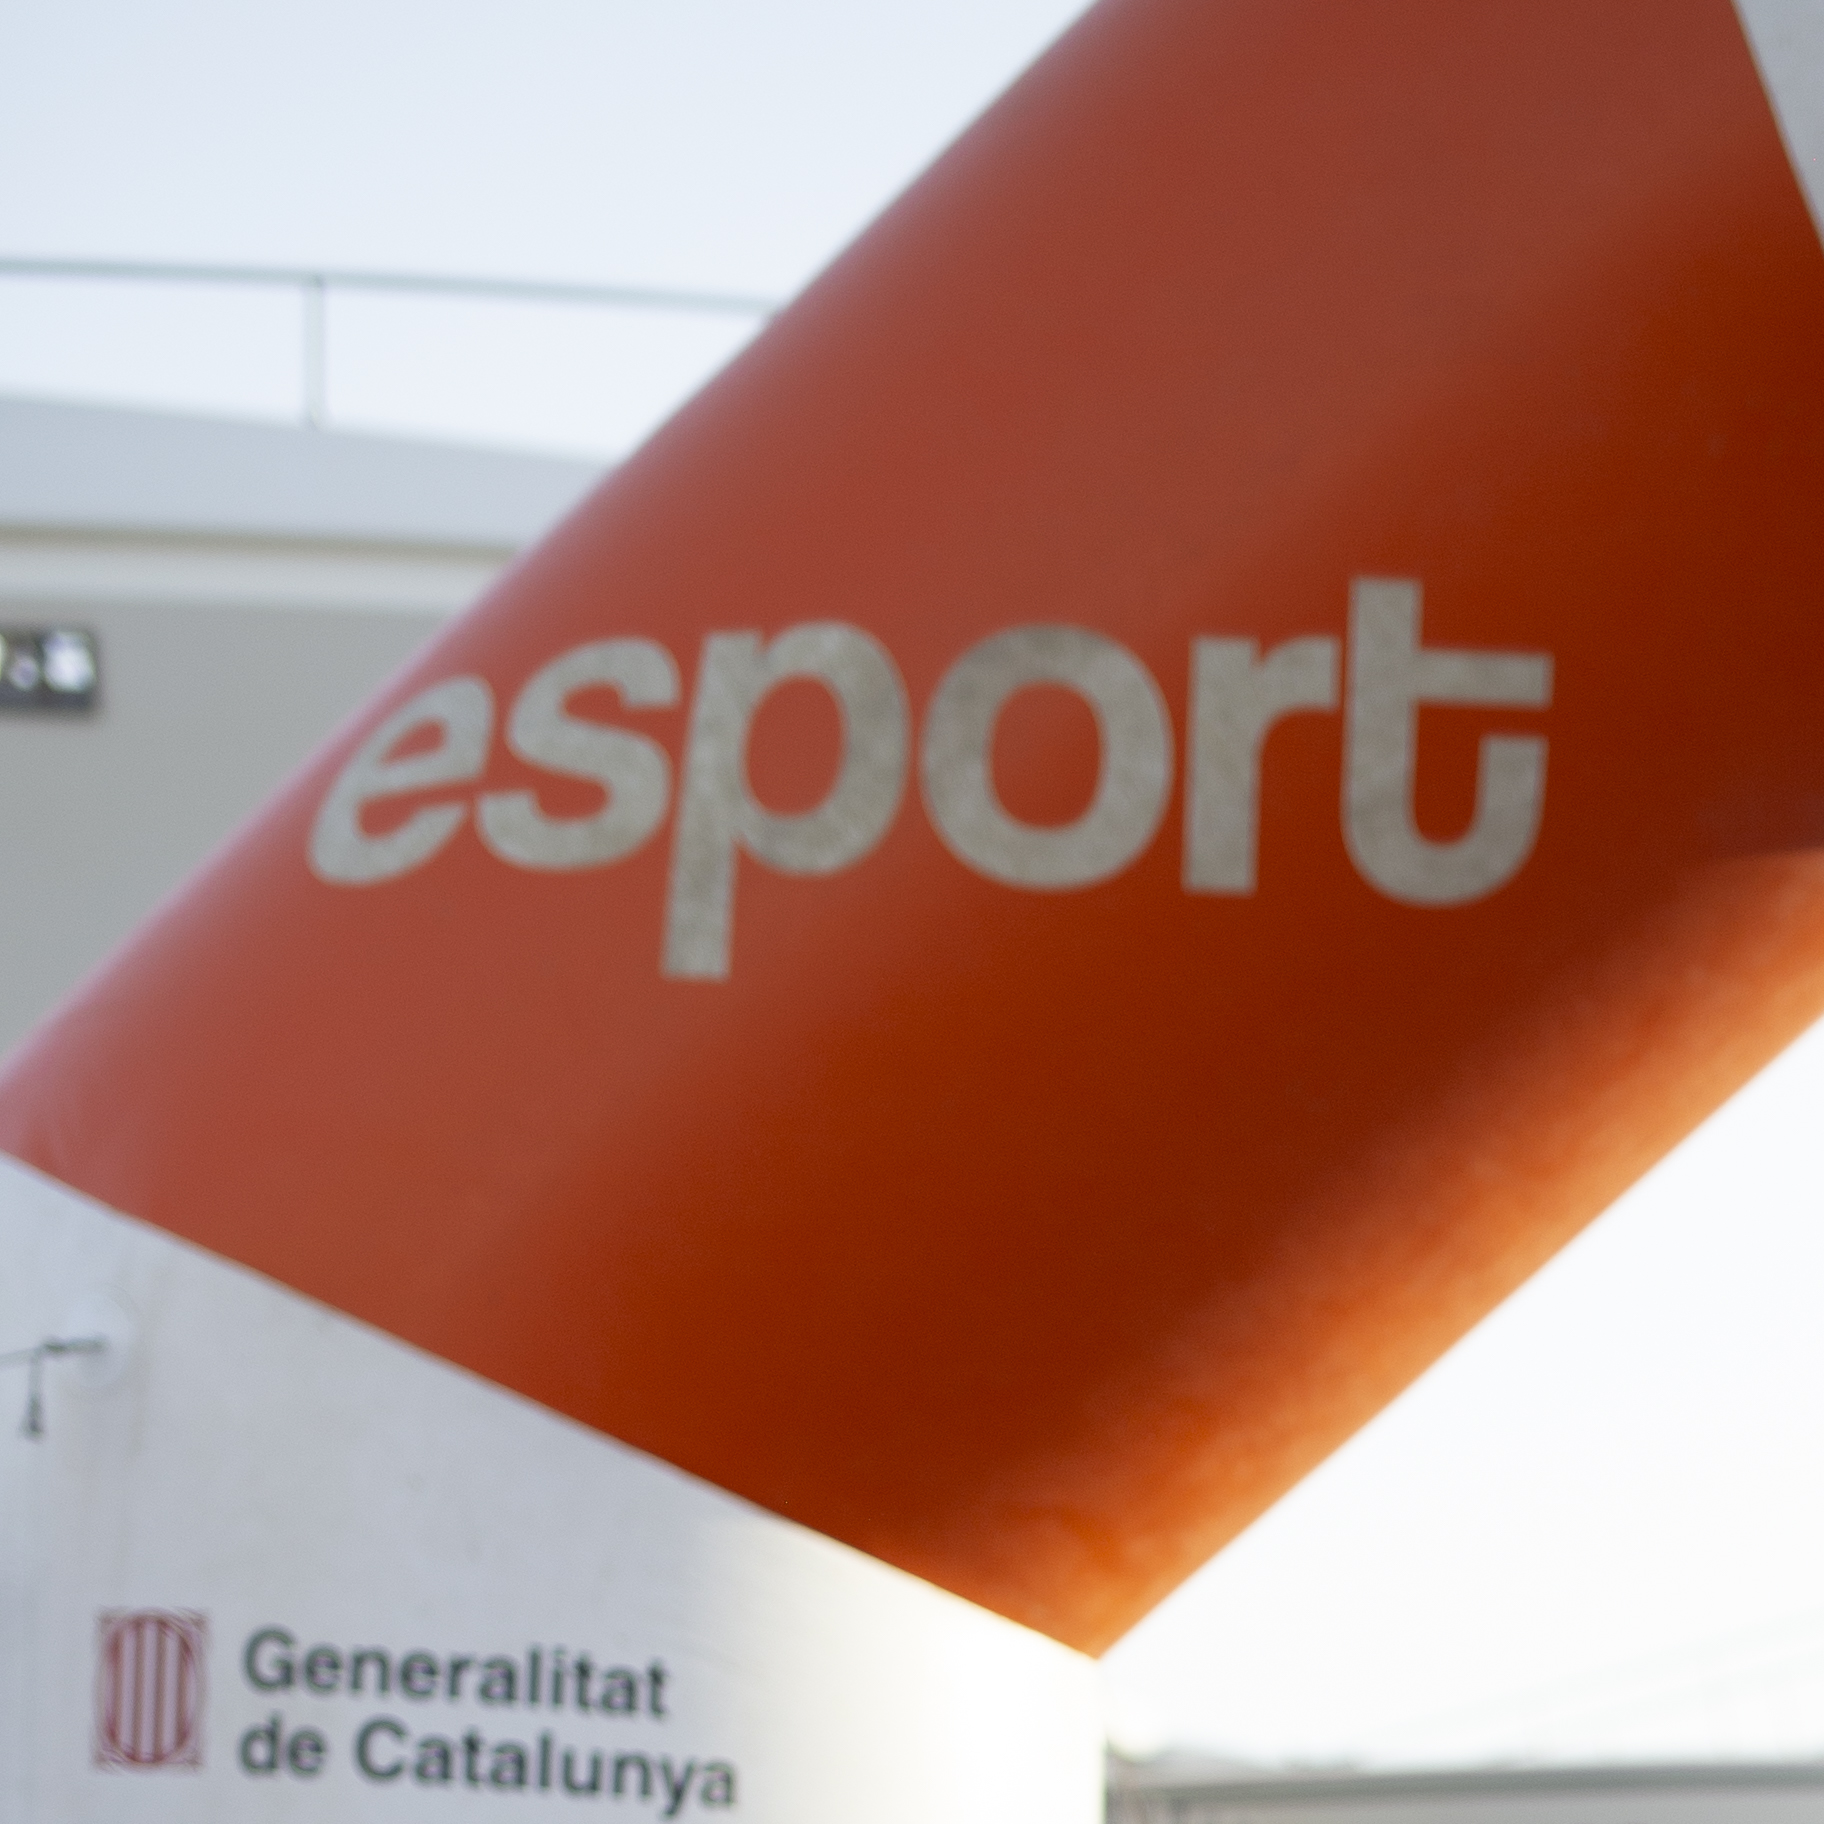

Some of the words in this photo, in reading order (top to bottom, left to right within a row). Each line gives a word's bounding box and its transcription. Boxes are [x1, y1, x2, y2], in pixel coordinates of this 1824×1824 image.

[305, 575, 1556, 981] esport
[243, 1626, 668, 1719] Generalitat
[238, 1713, 328, 1776] de
[353, 1716, 738, 1820] Catalunya
